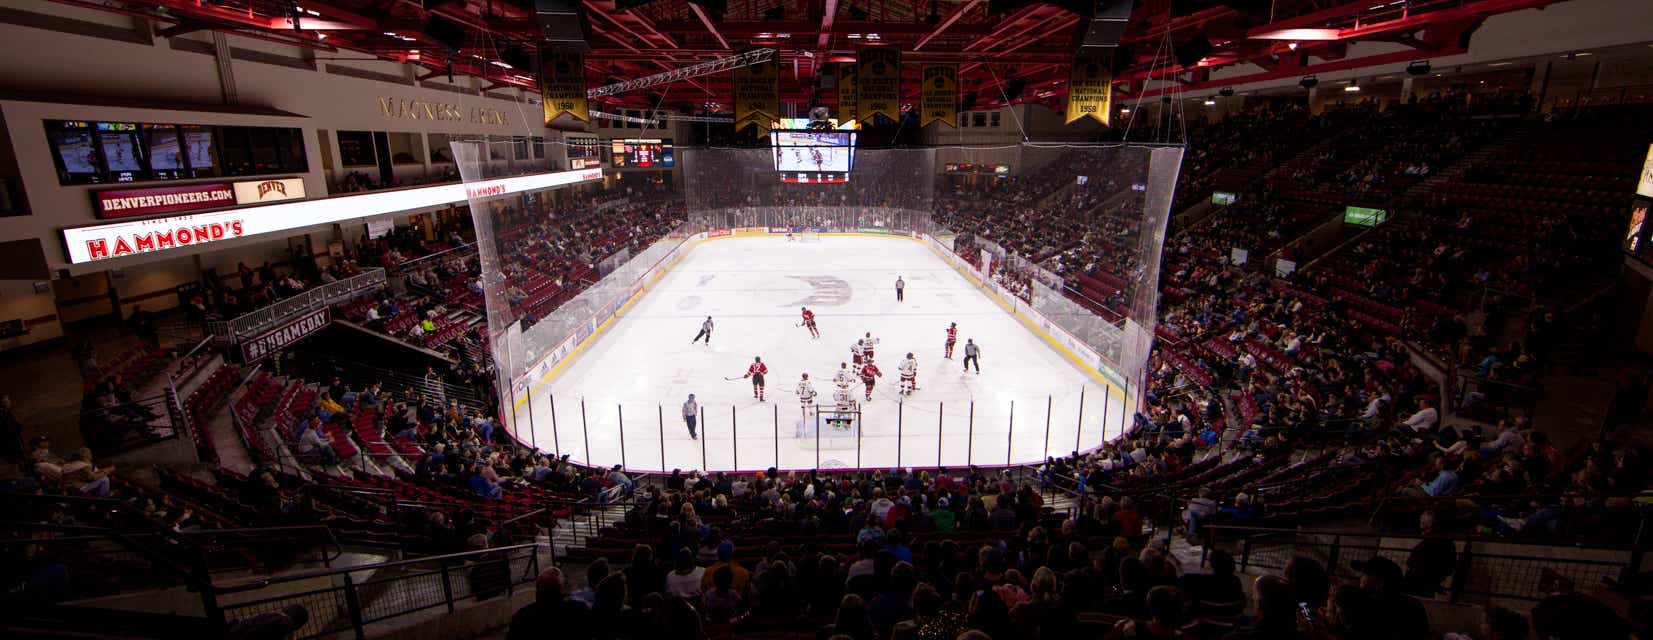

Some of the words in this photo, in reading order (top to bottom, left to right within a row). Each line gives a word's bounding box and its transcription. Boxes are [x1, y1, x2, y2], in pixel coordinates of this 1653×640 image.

[378, 95, 463, 122] MAGNESS
[470, 107, 509, 126] ARENA
[1080, 105, 1096, 113] 1958
[103, 189, 232, 211] DENVERPIONEERS.COM
[258, 181, 287, 200] DENVER
[87, 220, 243, 261] HAMMOND'S
[840, 393, 848, 401] 31
